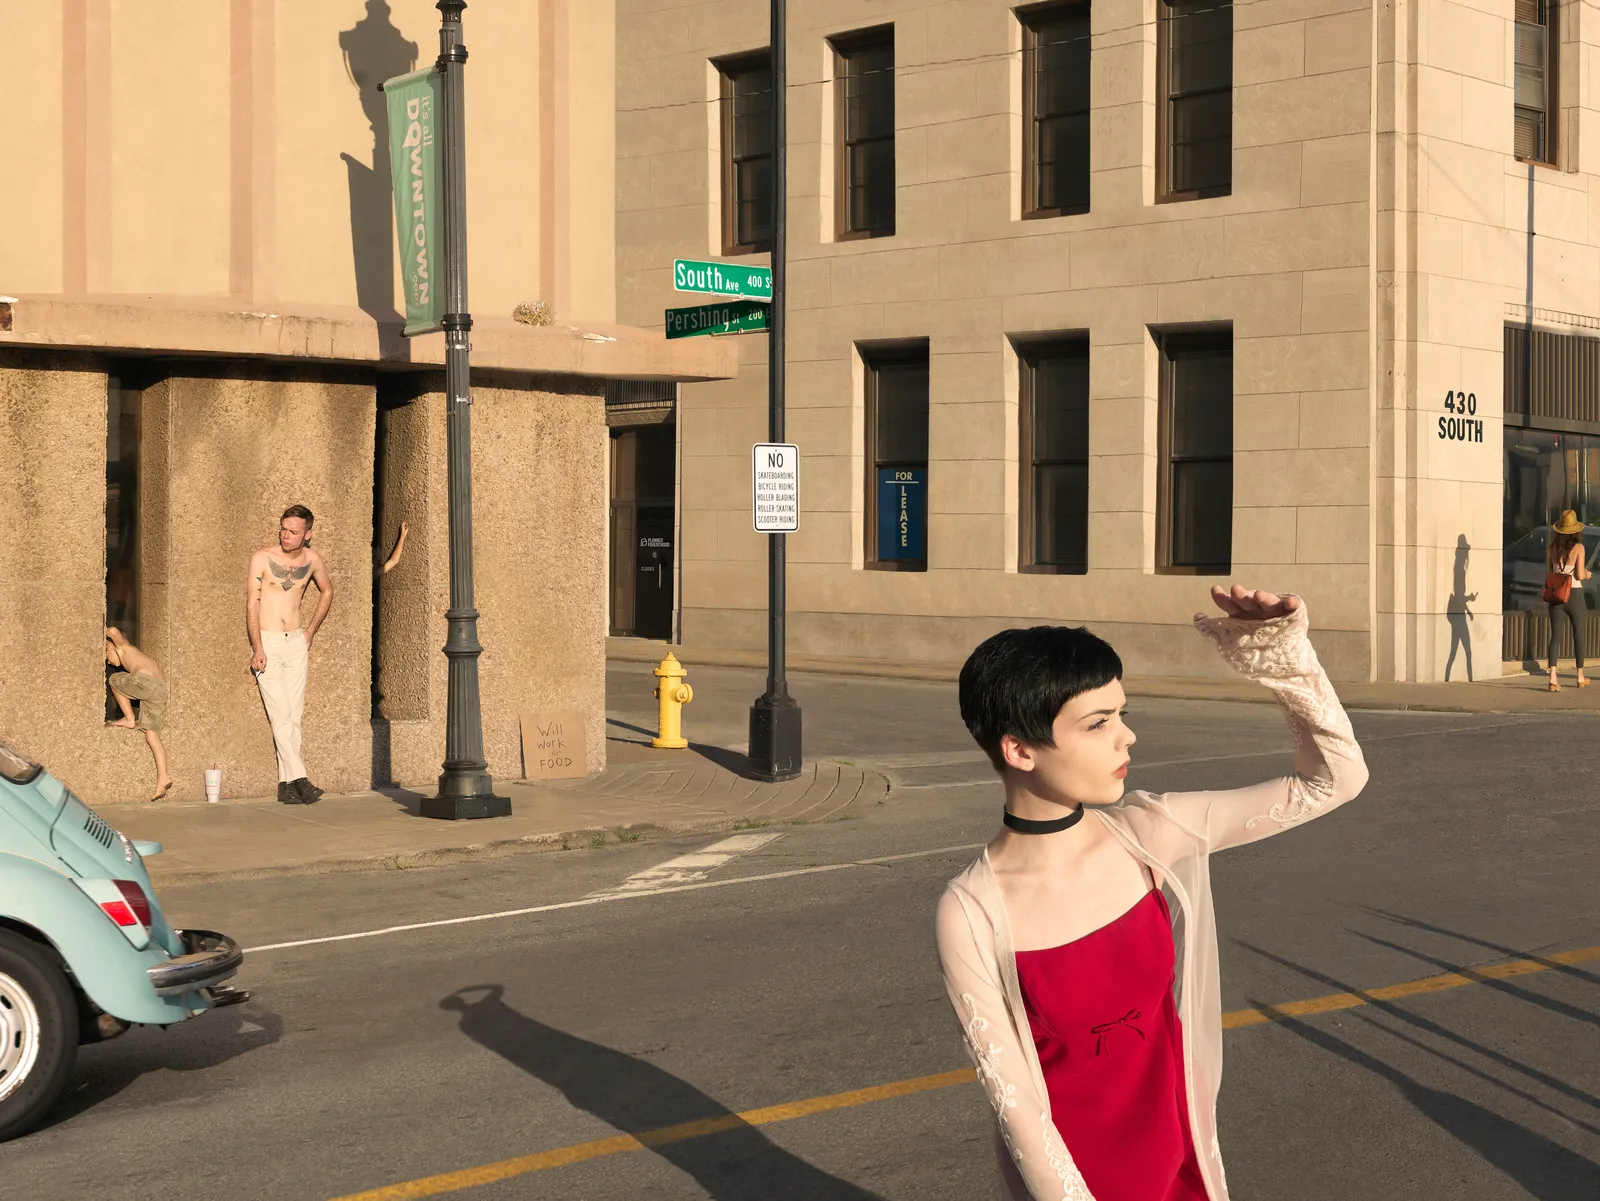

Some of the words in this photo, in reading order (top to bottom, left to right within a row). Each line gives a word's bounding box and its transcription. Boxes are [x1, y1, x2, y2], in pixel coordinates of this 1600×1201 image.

[423, 126, 432, 146] all
[402, 97, 430, 305] DOWNTOWN
[677, 263, 722, 289] South
[725, 279, 739, 292] Ave
[747, 275, 762, 288] 400
[667, 306, 729, 331] Pershing
[732, 312, 740, 324] St
[748, 308, 762, 320] 200
[1445, 390, 1476, 415] 430
[1438, 416, 1483, 443] SOUTH
[768, 453, 784, 468] NO
[896, 472, 912, 480] FOR
[900, 486, 908, 546] LEASE
[537, 722, 562, 736] Will
[540, 758, 572, 771] FOOD
